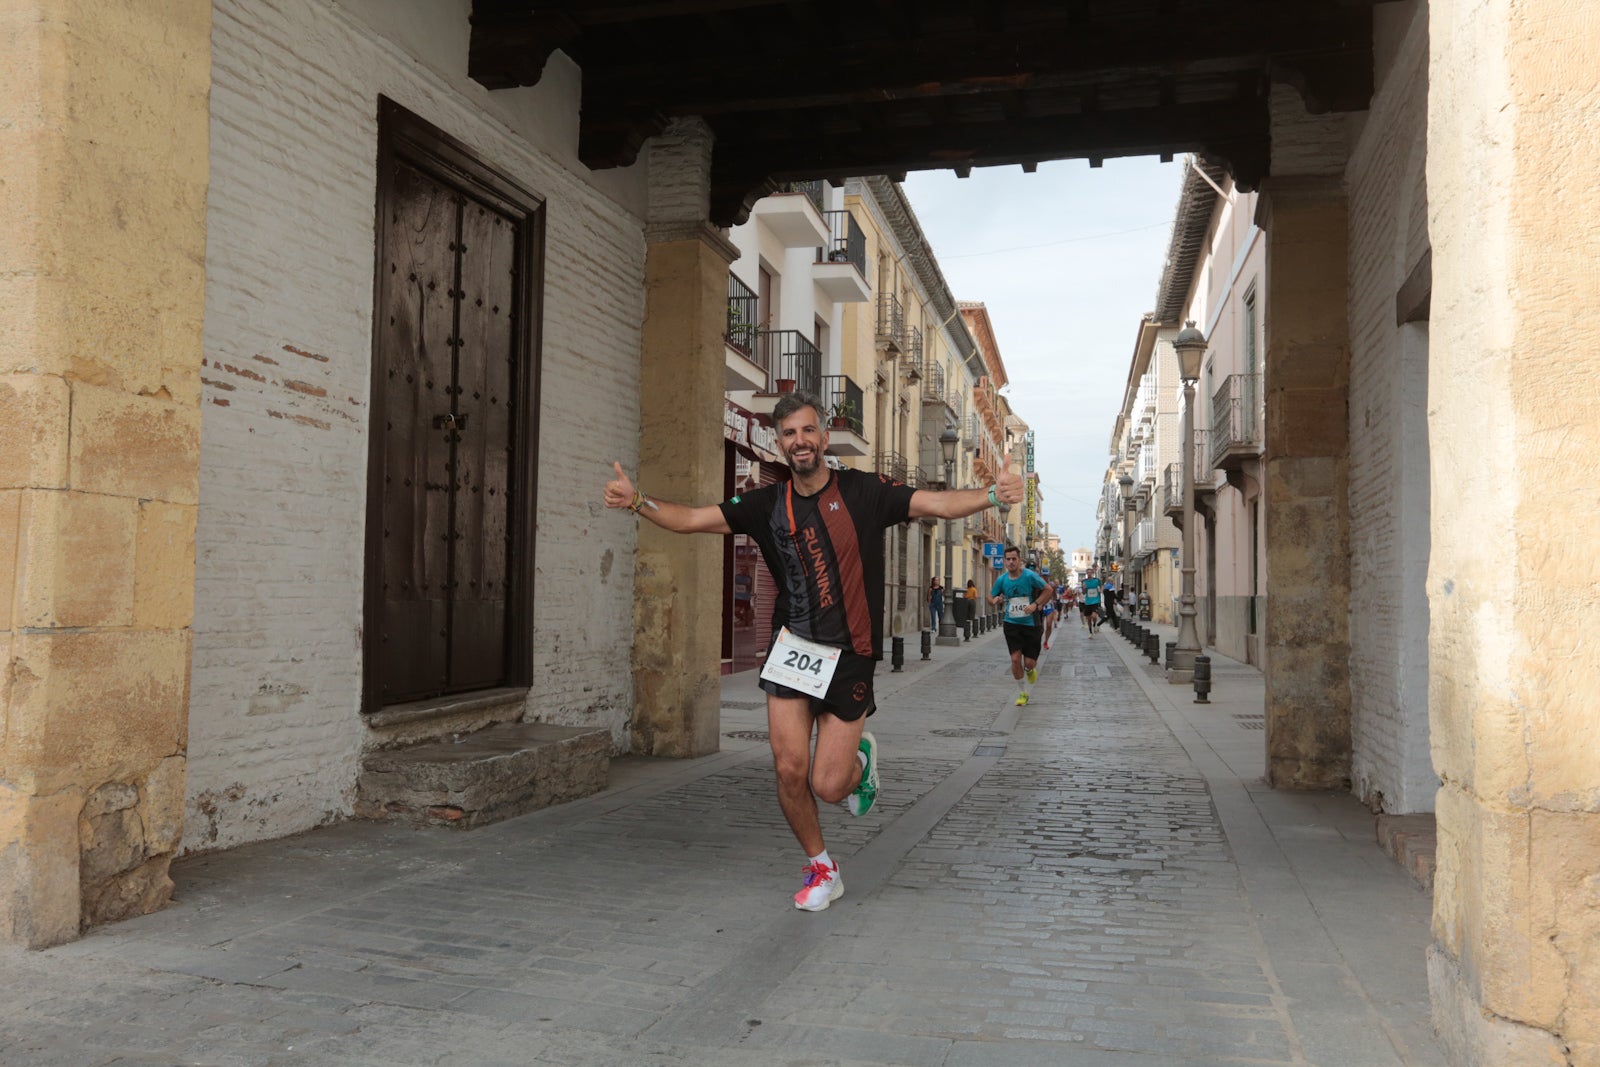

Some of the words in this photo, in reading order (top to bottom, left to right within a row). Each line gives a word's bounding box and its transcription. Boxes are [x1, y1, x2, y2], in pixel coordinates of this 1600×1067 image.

[775, 526, 806, 615] GRANADA
[802, 527, 833, 609] RUNNING
[783, 650, 823, 675] 204
